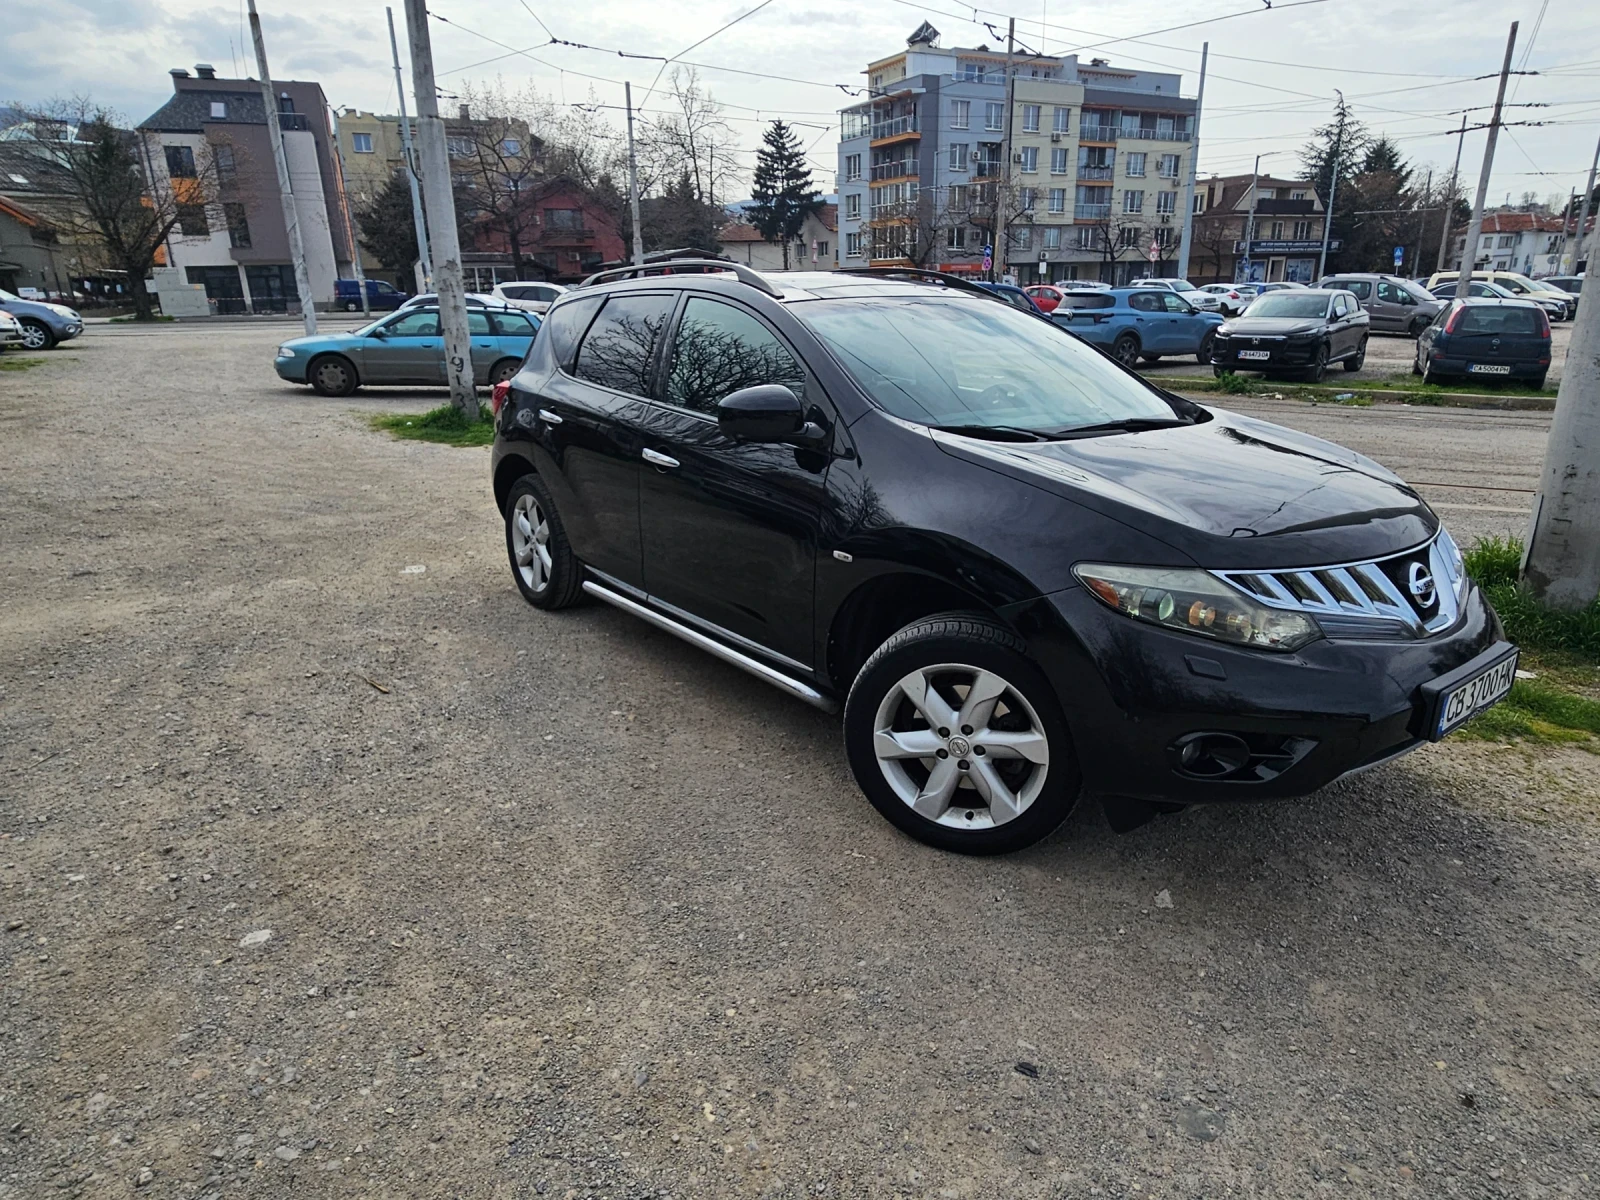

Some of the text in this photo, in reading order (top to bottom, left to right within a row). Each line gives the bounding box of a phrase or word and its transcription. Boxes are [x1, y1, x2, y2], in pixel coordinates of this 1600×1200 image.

[1447, 687, 1466, 723] CB
[1466, 668, 1499, 711] 3700
[1497, 656, 1516, 692] HK
